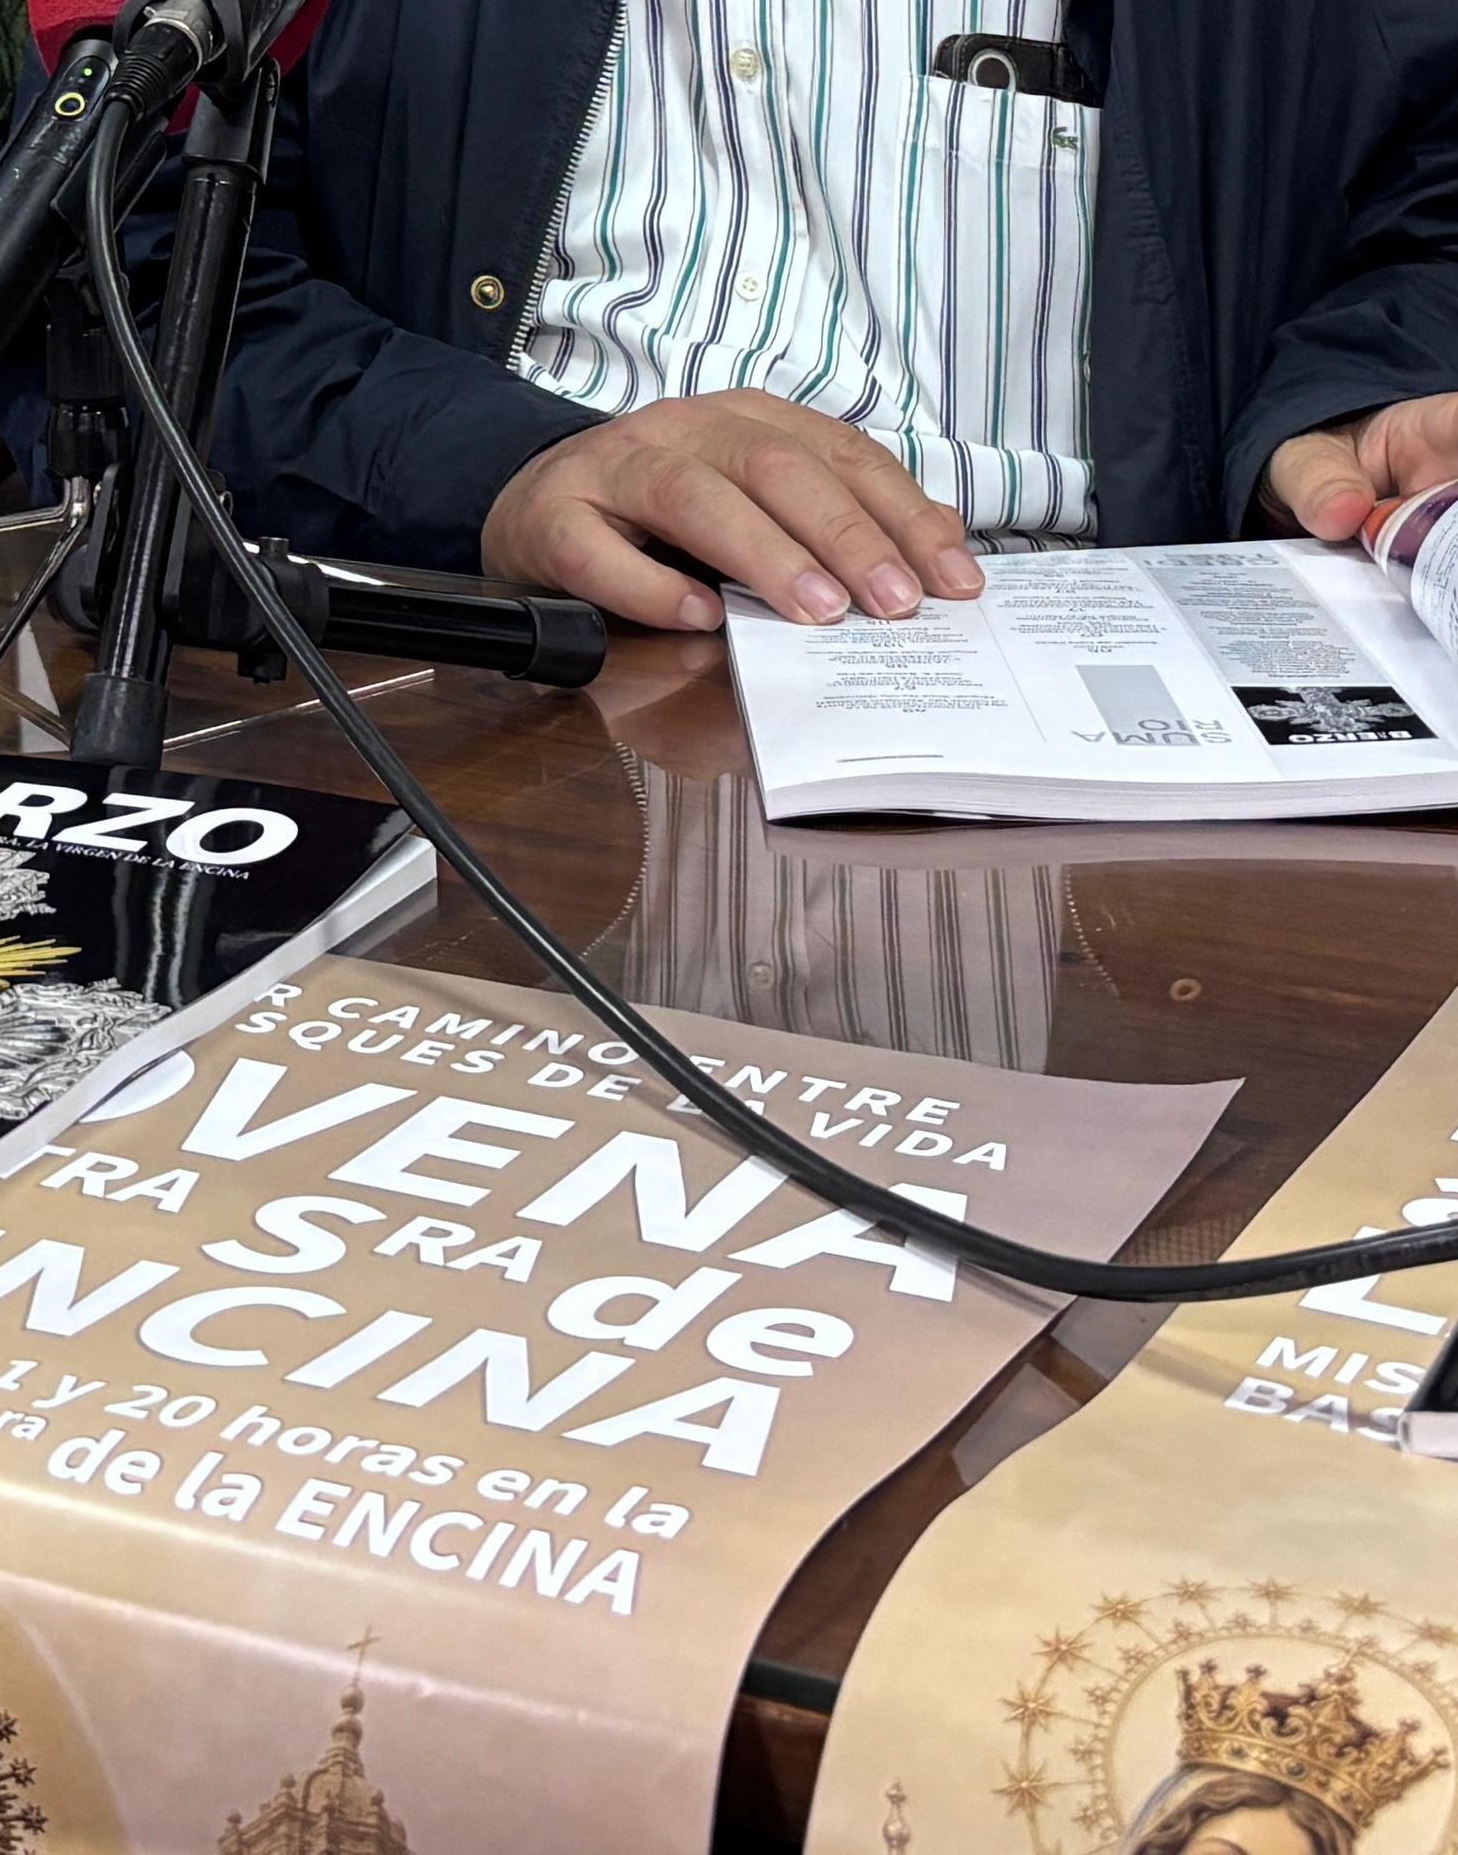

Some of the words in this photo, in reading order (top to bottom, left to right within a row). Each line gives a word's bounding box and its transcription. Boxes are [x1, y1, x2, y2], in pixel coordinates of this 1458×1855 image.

[55, 843, 124, 861] VIRGEN
[177, 861, 250, 880] ENCINA
[234, 1010, 506, 1075] SQUES
[527, 1056, 644, 1102] DE
[809, 1112, 1007, 1171] VIDA
[326, 997, 641, 1064] CAMINO
[201, 1194, 543, 1283] SRA
[548, 1266, 855, 1378] de
[38, 1374, 108, 1410] y
[103, 1383, 217, 1429] 20
[219, 1405, 465, 1487] horas
[475, 1468, 588, 1517] en
[603, 1485, 690, 1540] la
[46, 1429, 163, 1495] de
[174, 1451, 264, 1522] la
[274, 1478, 642, 1617] ENCINA
